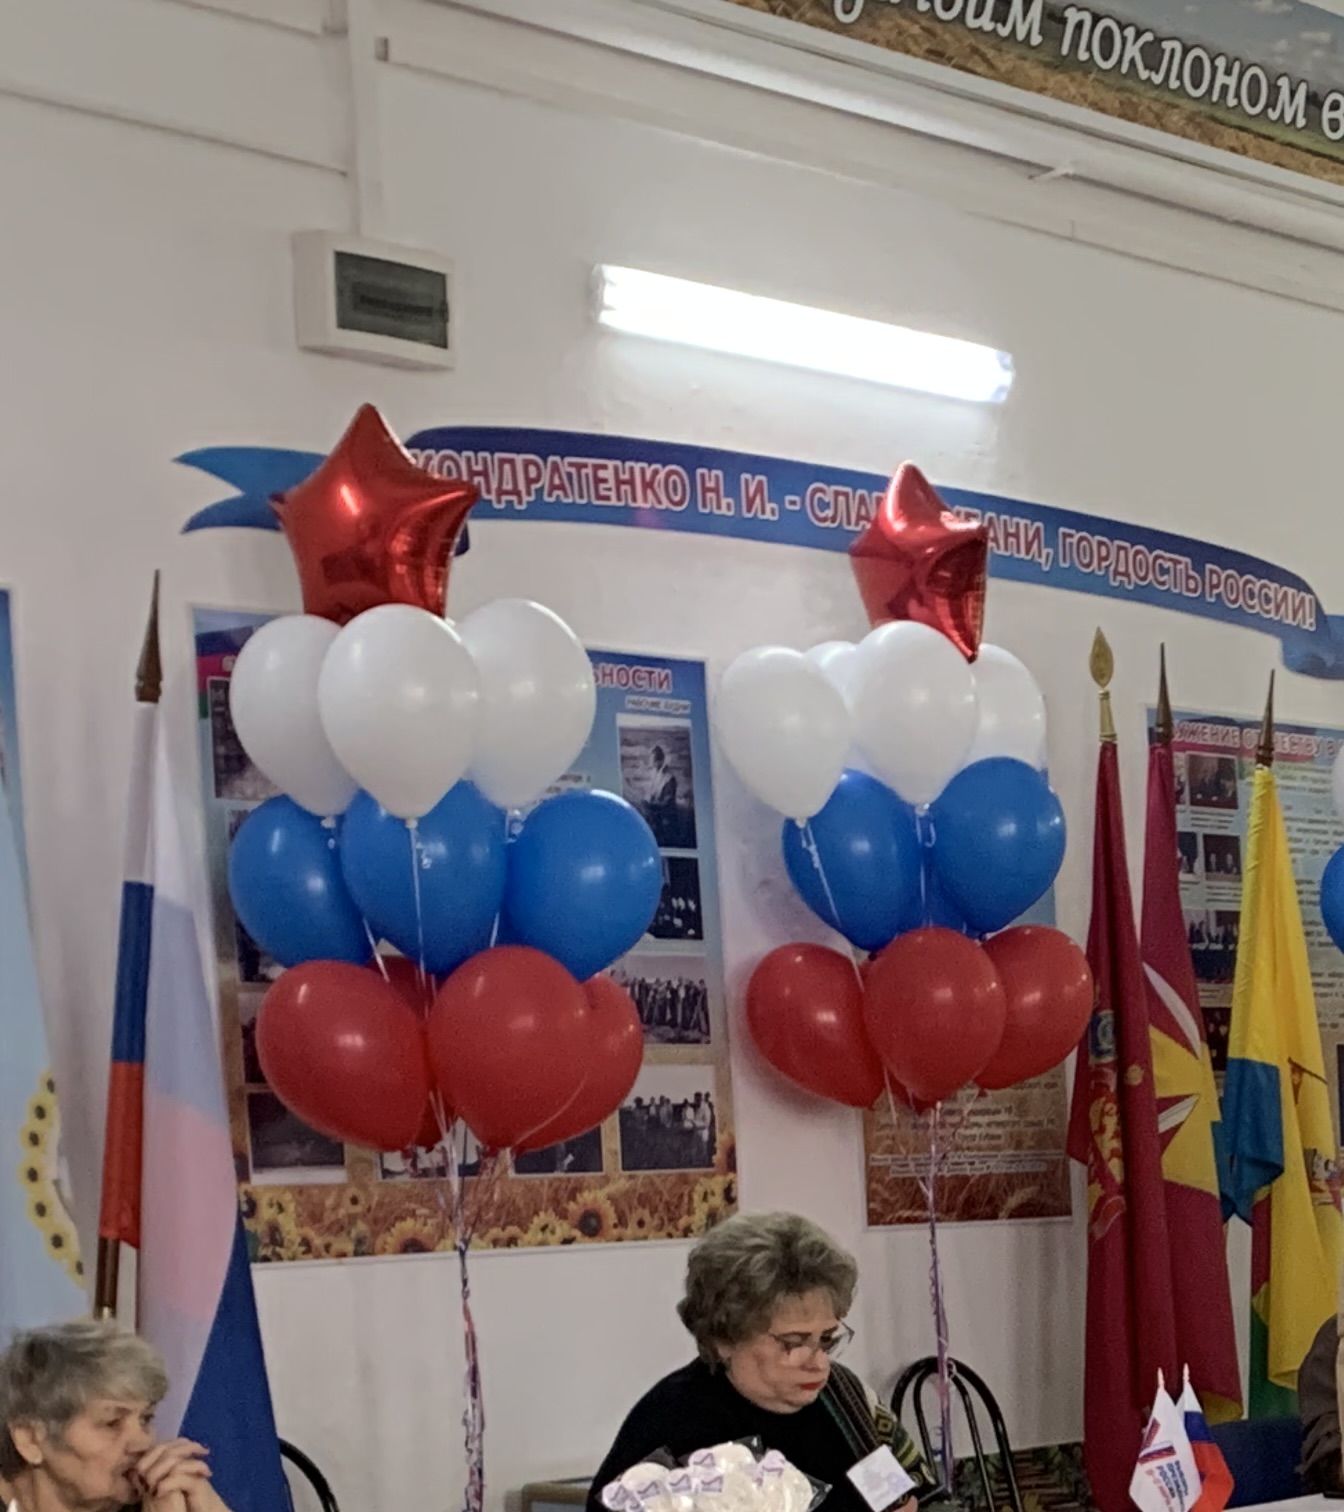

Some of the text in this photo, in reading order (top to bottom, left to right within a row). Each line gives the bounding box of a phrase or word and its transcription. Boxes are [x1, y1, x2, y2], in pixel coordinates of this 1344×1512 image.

[1060, 6, 1308, 129] поклоном
[698, 469, 735, 517] Н.
[741, 474, 778, 520] И.
[1059, 527, 1201, 600] ГОРДОСТЬ
[1204, 562, 1316, 631] РОССИИ!
